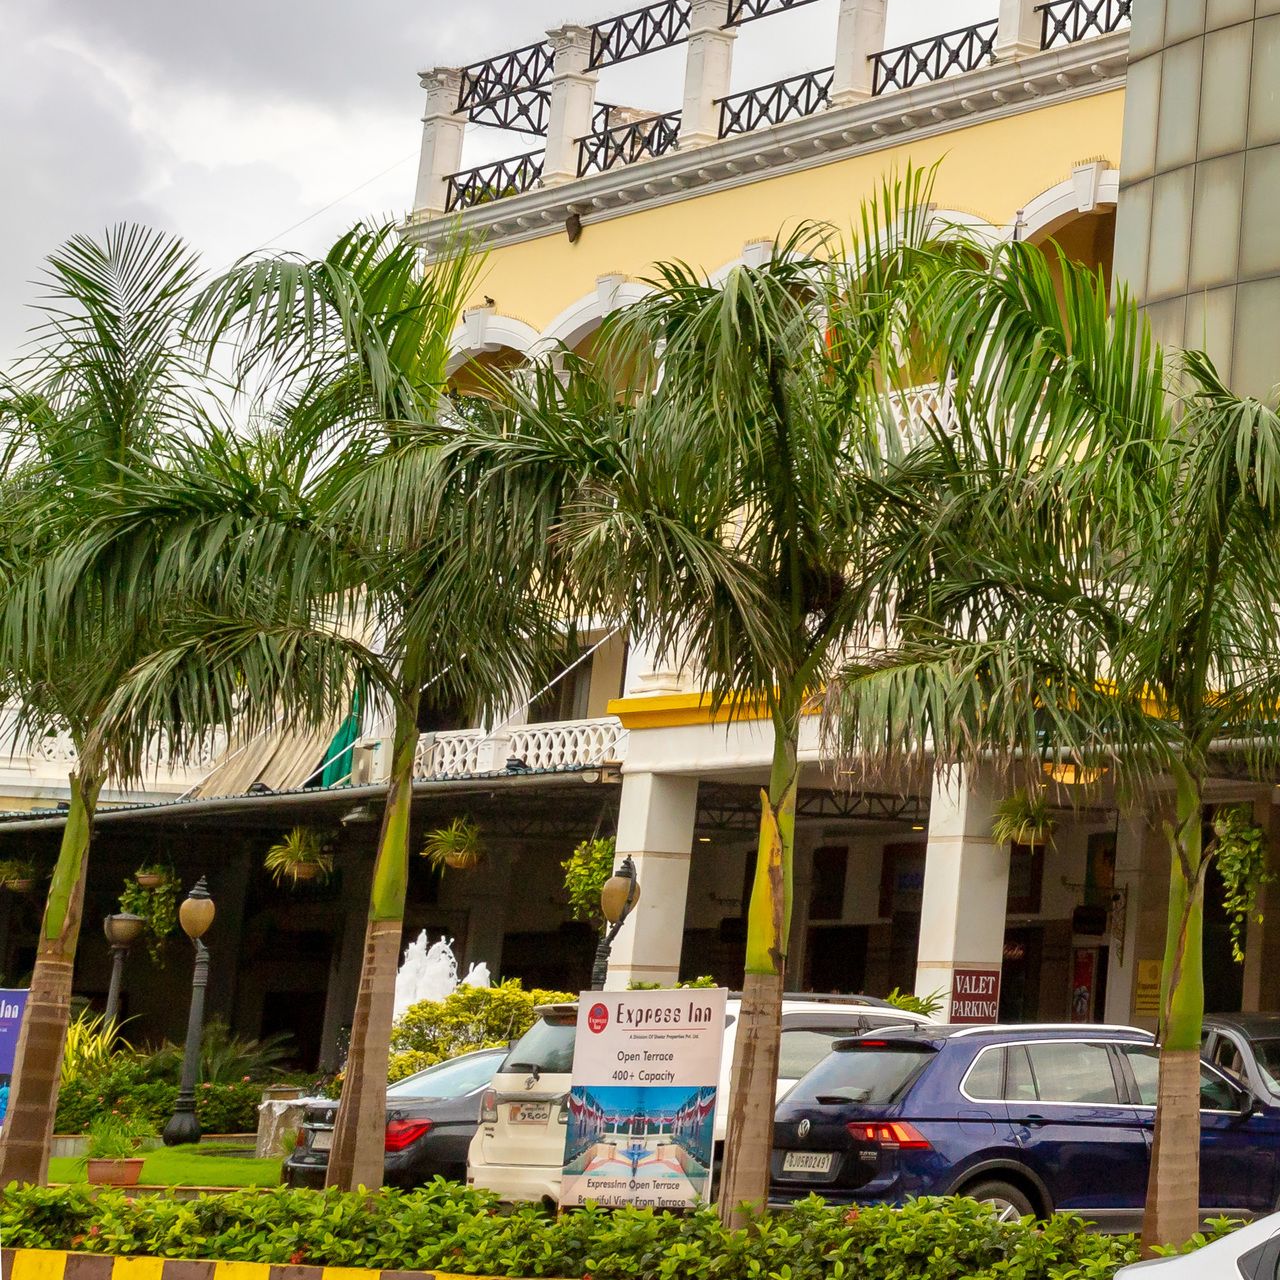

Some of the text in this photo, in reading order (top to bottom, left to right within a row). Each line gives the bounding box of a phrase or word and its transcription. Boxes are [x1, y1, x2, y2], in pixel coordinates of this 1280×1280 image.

[956, 975, 995, 994] VALET
[0, 1000, 19, 1018] Inn
[616, 1002, 712, 1027] Express Inn
[952, 1001, 997, 1018] PARKING
[617, 1050, 674, 1063] Open Terrace
[612, 1070, 675, 1083] 400+ Capacity
[587, 1179, 680, 1191] ExpressInn Open Terrace
[635, 1196, 655, 1206] From
[657, 1197, 686, 1207] Terrace
